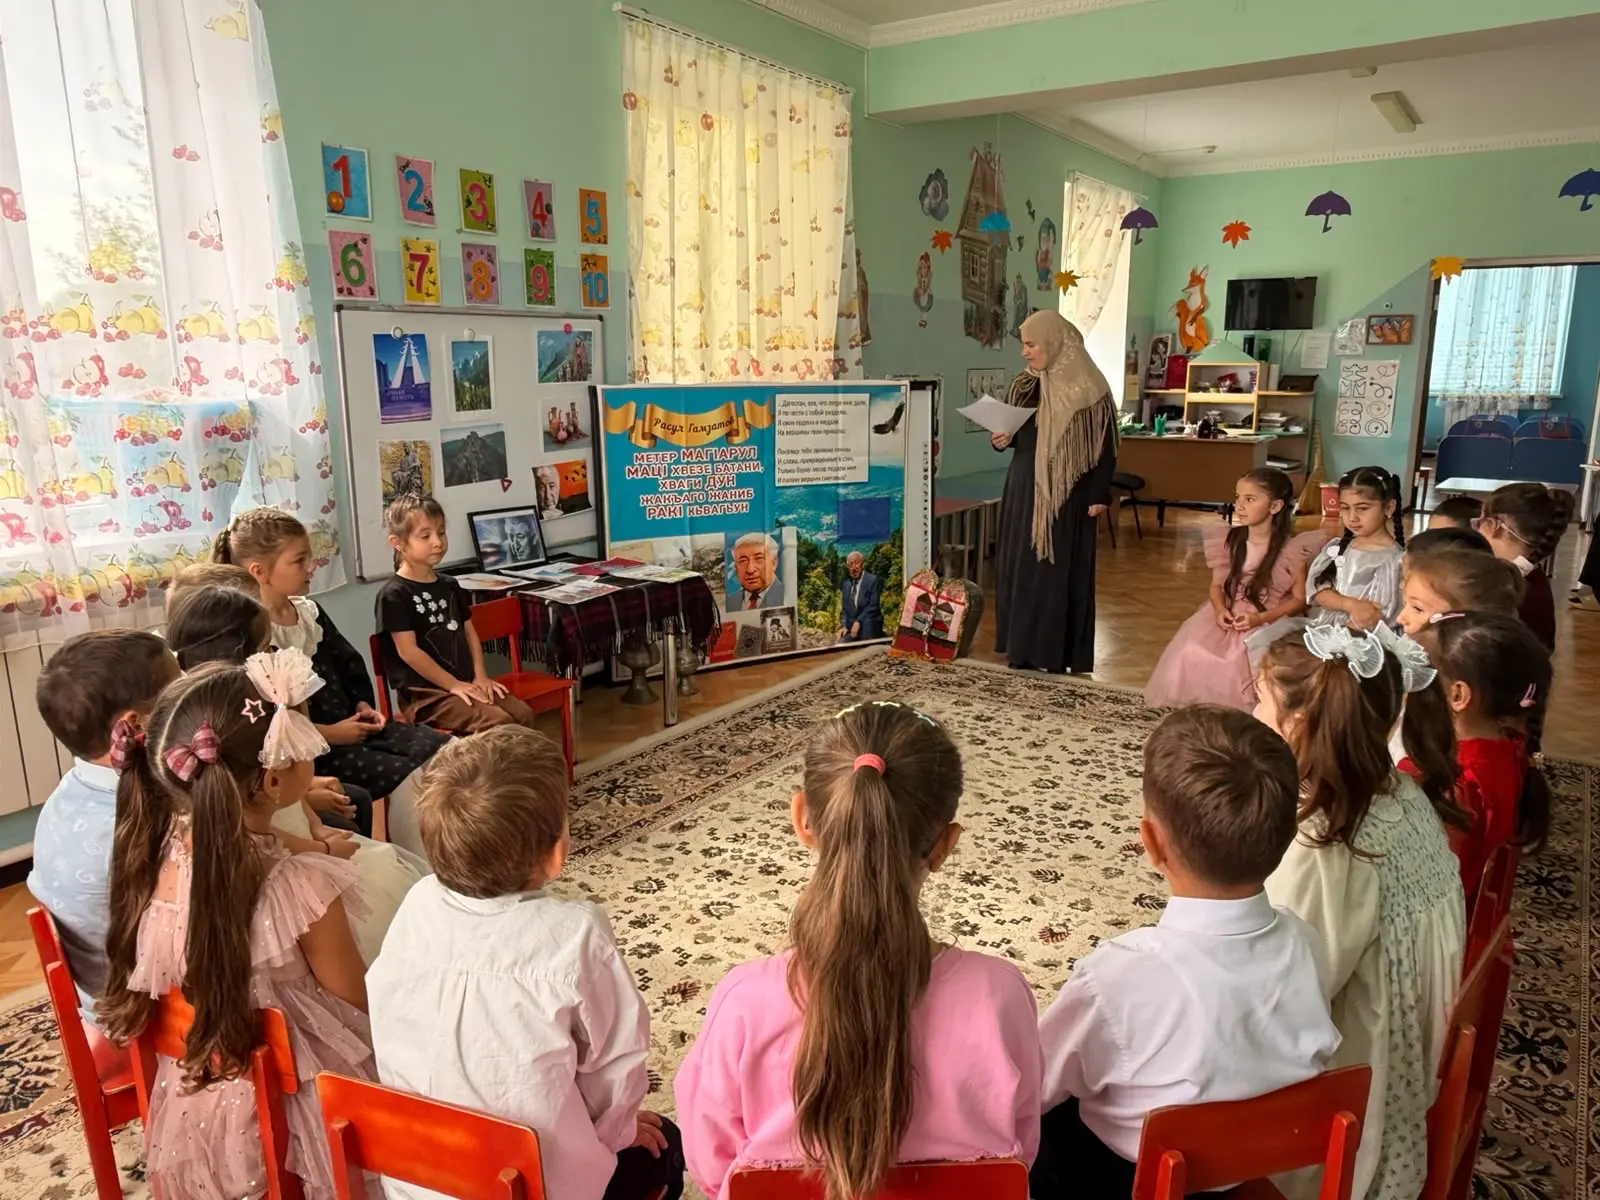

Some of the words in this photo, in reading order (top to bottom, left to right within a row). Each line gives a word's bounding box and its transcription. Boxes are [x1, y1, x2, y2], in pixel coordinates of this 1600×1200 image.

[333, 155, 350, 198] 1
[404, 169, 426, 212] 2
[468, 183, 489, 222] 3
[531, 191, 548, 228] 4
[585, 200, 602, 235] 5
[340, 242, 366, 287] 6
[409, 253, 430, 294] 7
[471, 260, 491, 301] 8
[531, 264, 548, 301] 9
[583, 272, 608, 304] 10
[653, 417, 685, 435] Расул
[688, 416, 735, 435] Гамзатов
[634, 452, 677, 463] МЕТЕР
[672, 464, 712, 476] ХВЕЗЕ
[715, 461, 765, 474] БАТАНИ,
[640, 492, 705, 507] ЖАКЪАГО
[709, 488, 754, 501] ЖАНИБ
[660, 479, 702, 490] ХВАГИ
[705, 474, 736, 490] ДУН
